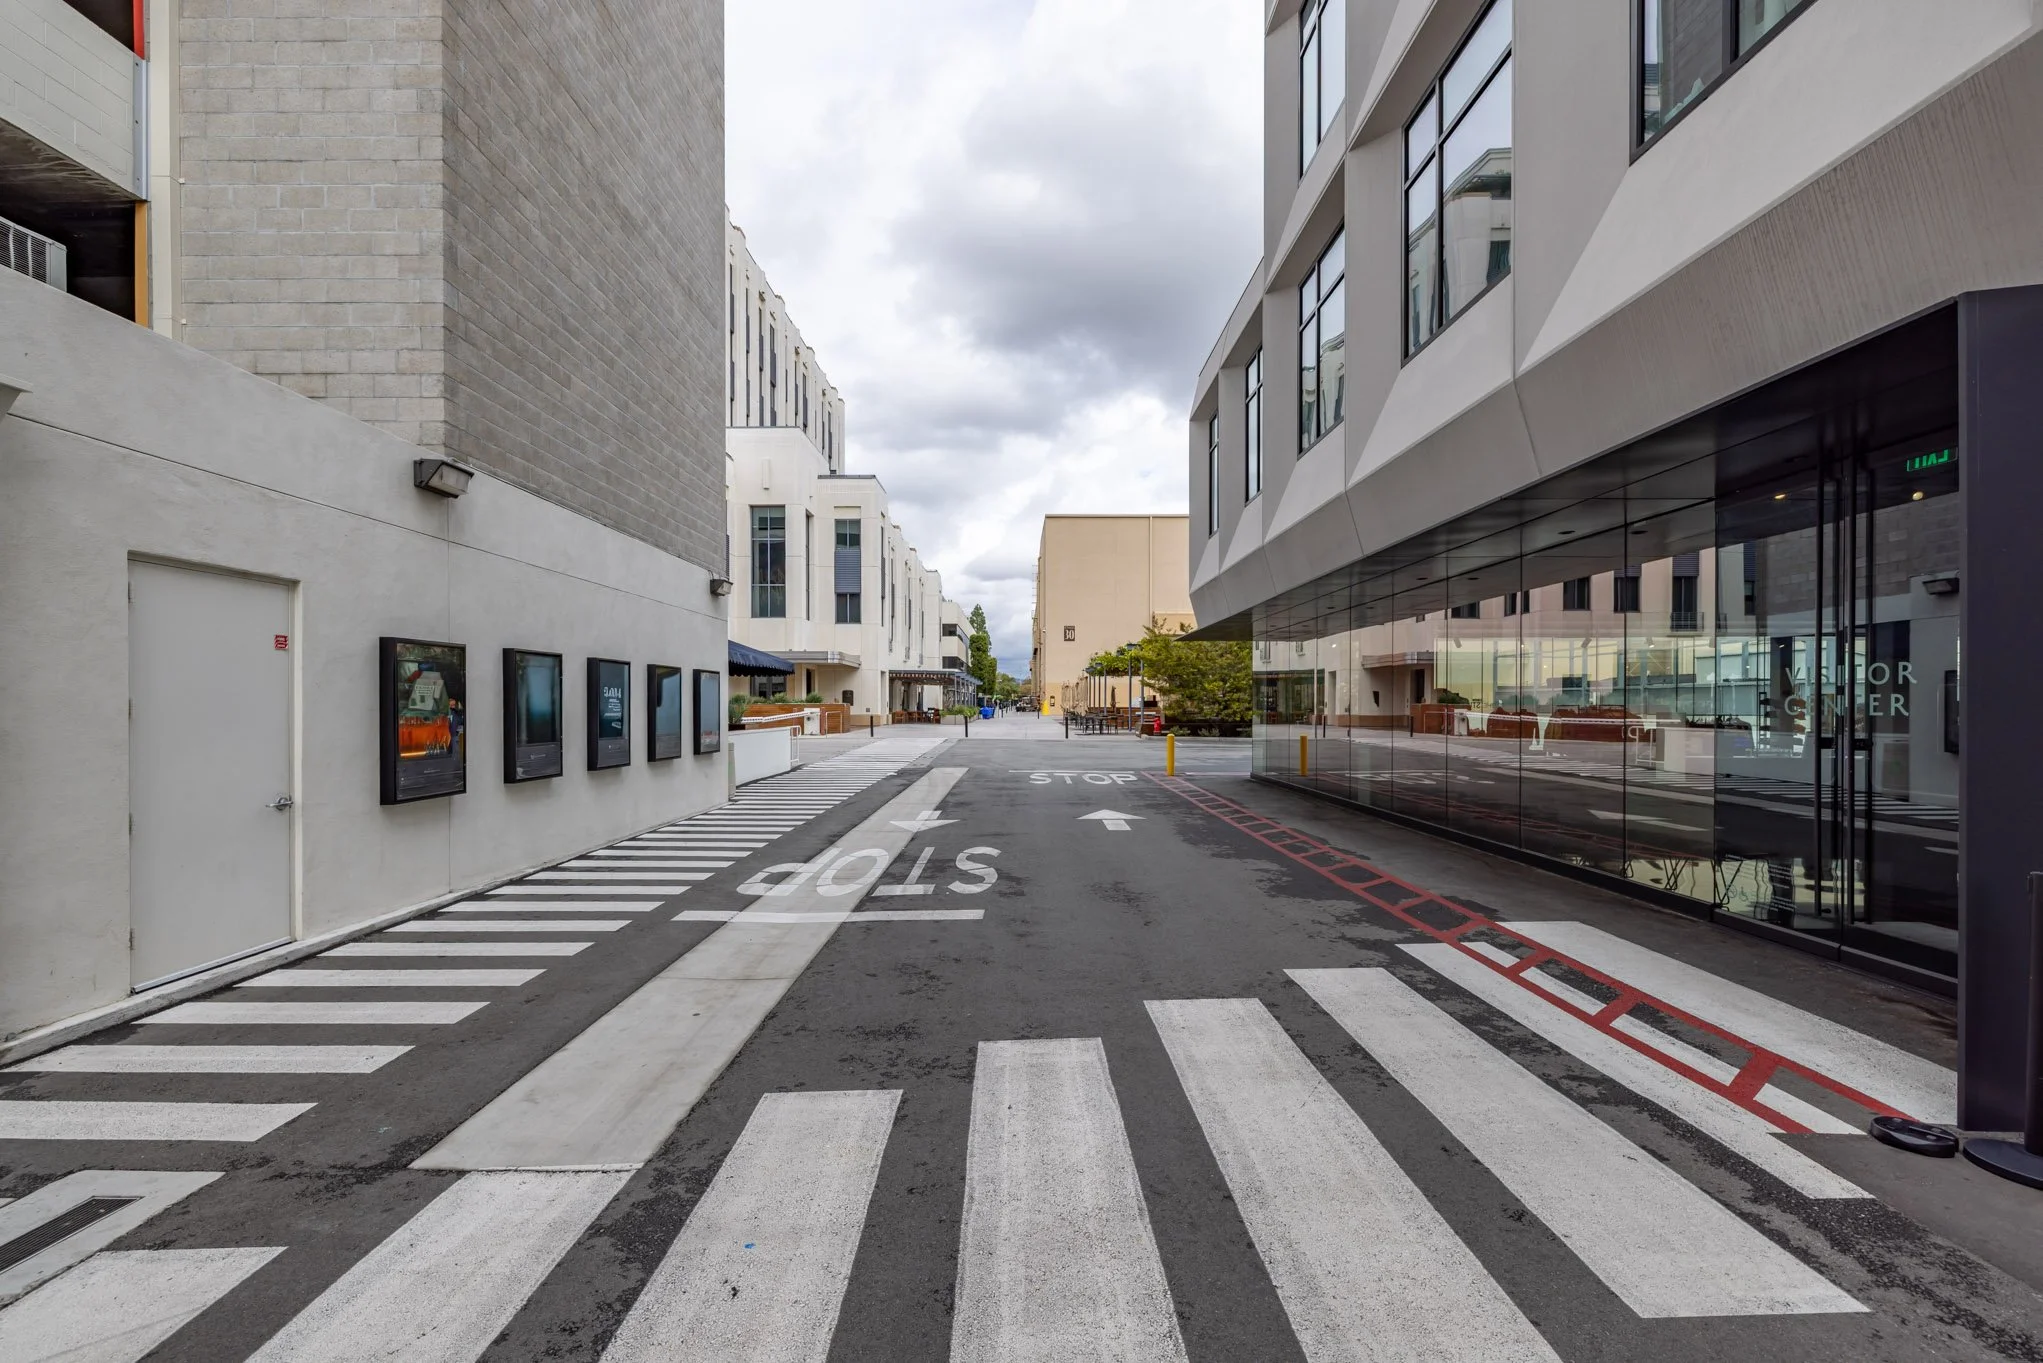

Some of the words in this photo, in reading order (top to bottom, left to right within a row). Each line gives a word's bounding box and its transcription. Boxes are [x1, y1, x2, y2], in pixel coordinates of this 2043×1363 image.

[1785, 661, 1918, 687] VISITOR
[1784, 693, 1910, 717] CENTER
[1028, 773, 1139, 785] STOP
[736, 847, 1002, 896] STOP
